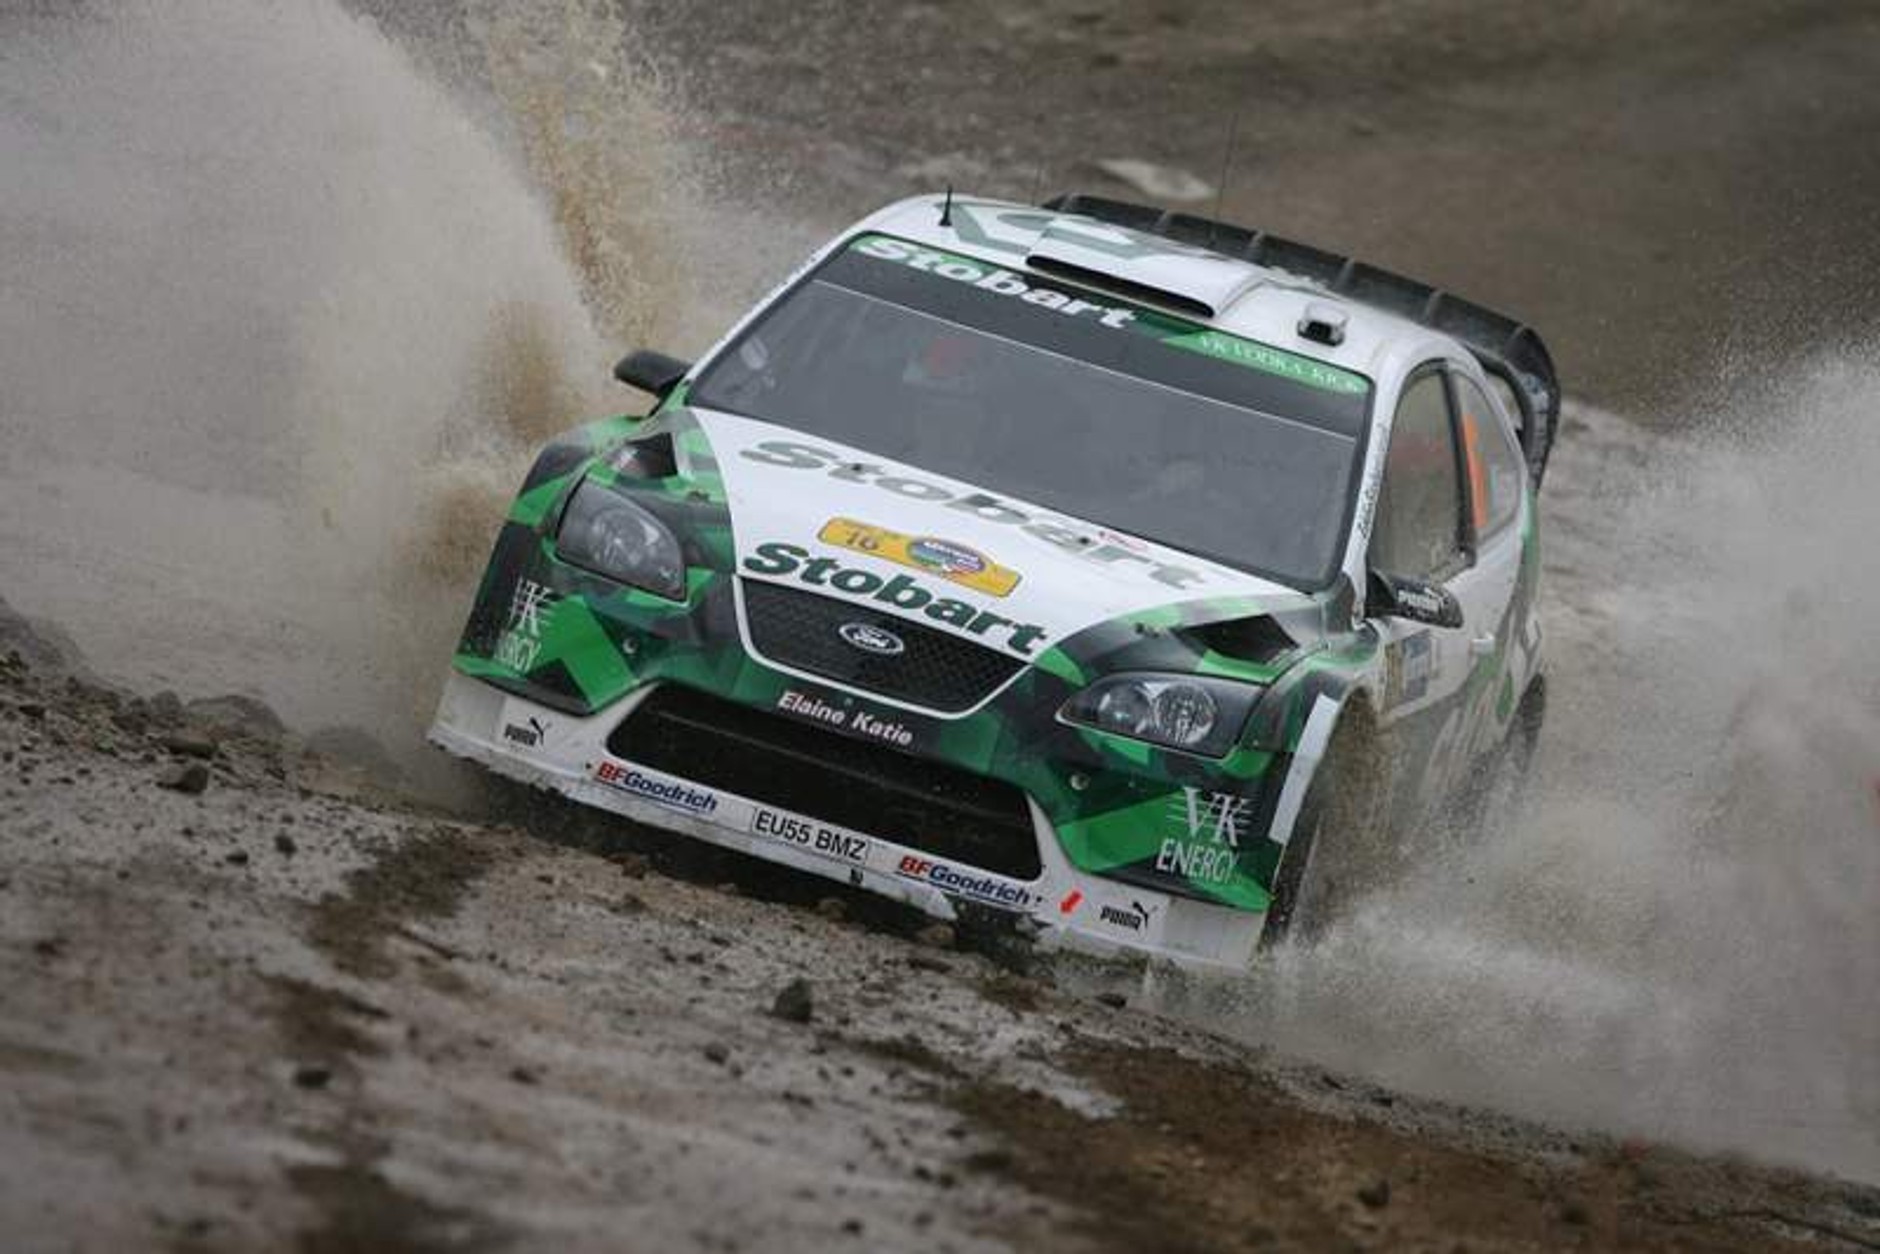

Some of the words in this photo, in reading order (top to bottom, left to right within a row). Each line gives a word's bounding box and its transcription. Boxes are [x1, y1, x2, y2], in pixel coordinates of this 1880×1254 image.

[857, 237, 1136, 328] Stobart
[740, 441, 1205, 590] Stobart
[744, 542, 1048, 655] Stobart
[777, 691, 845, 725] Elaine
[851, 712, 913, 746] Katie
[598, 761, 717, 812] BFGoodrich
[755, 811, 810, 843] EU55
[815, 829, 866, 861] BMZ
[1183, 786, 1250, 846] VK
[899, 854, 1030, 904] BFGoodrich
[1156, 838, 1240, 884] ENERGY
[1100, 906, 1141, 930] PUMA
